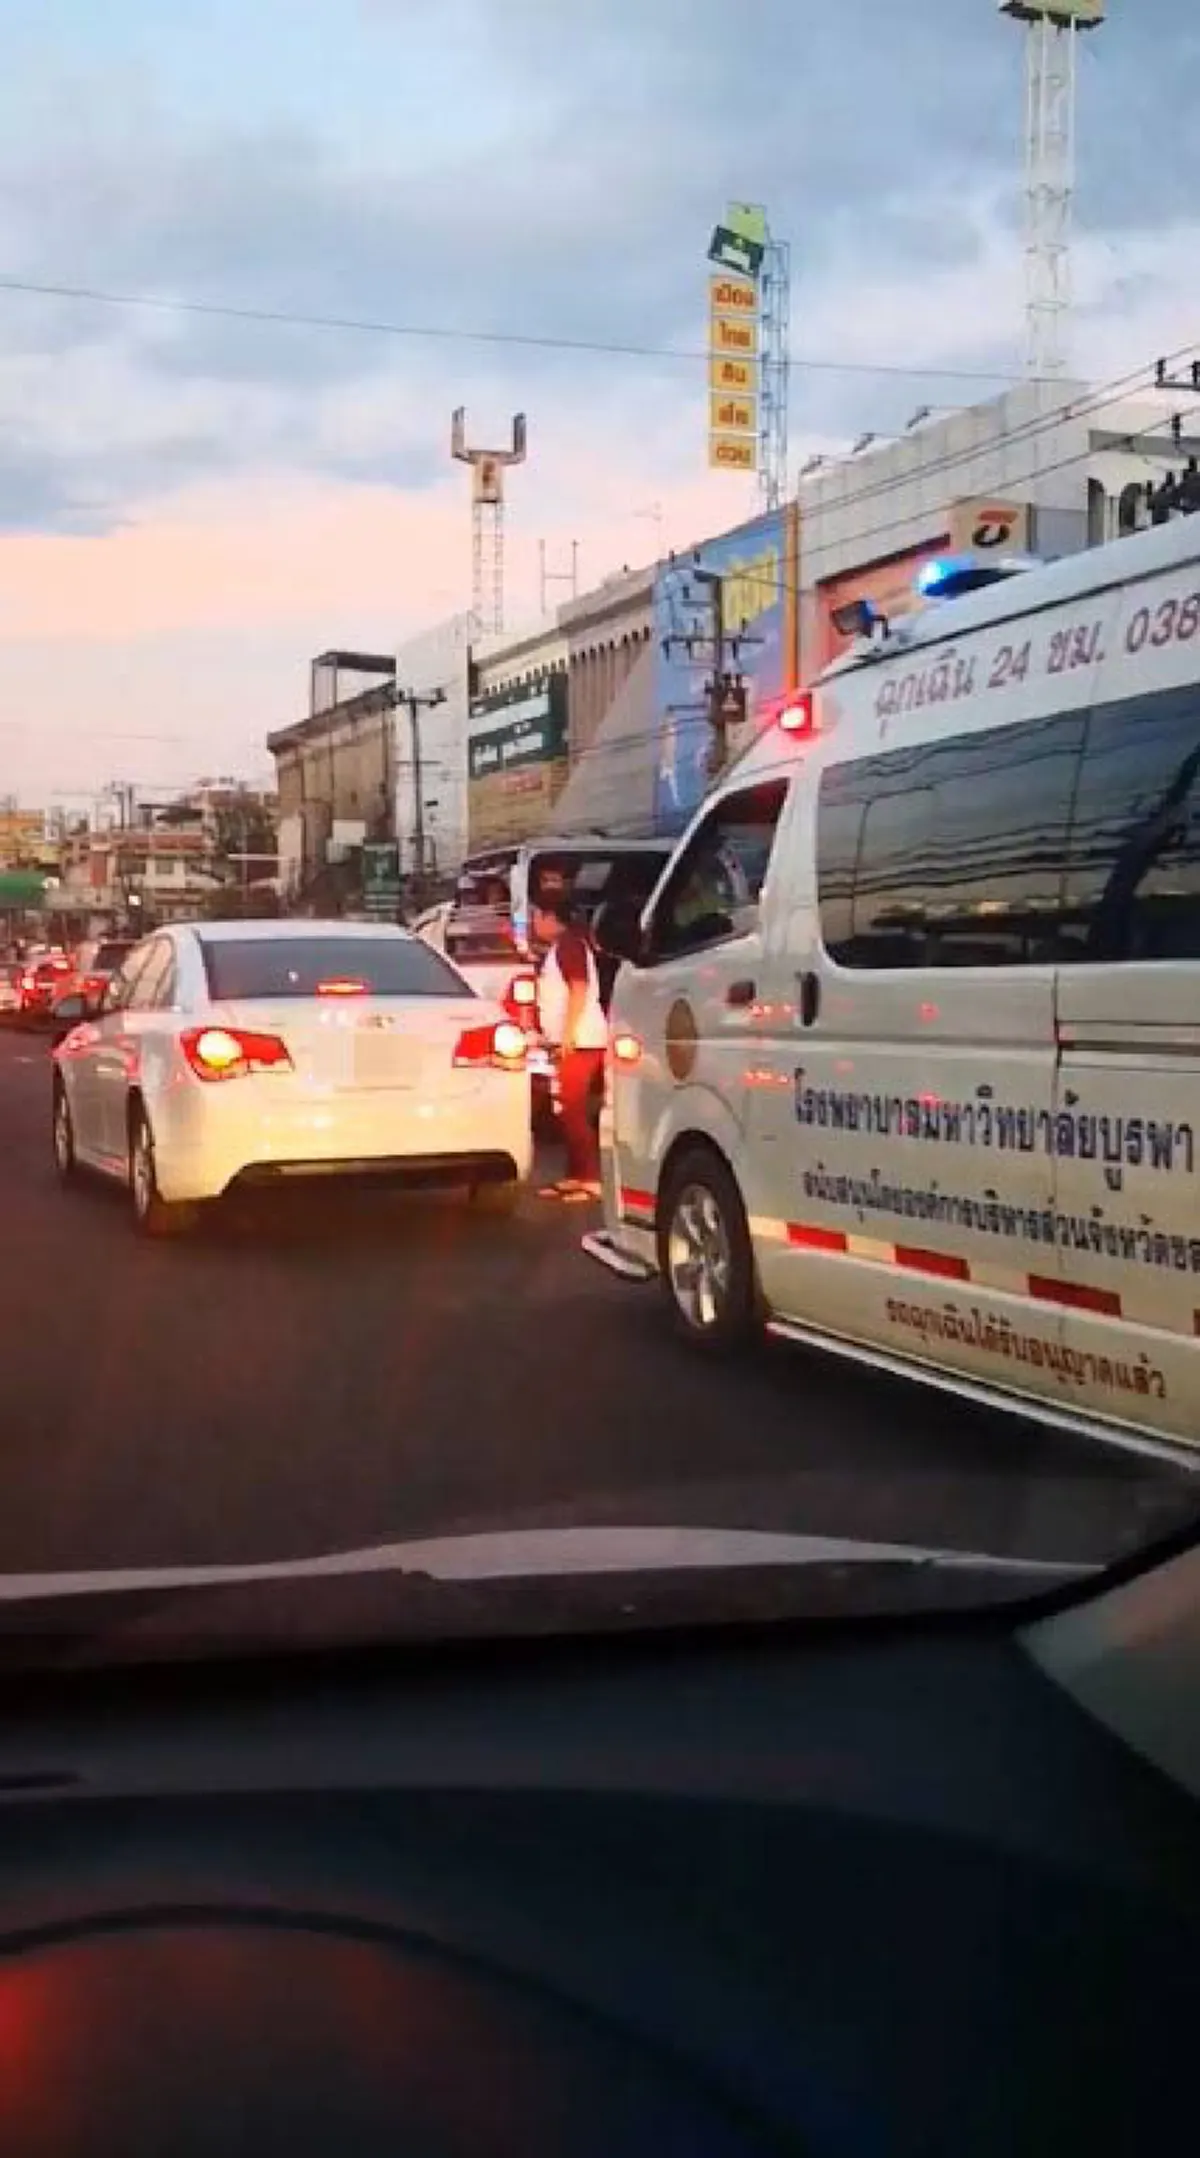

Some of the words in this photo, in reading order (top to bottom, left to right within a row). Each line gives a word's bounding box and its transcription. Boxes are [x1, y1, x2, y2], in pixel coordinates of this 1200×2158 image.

[875, 648, 977, 739] ฉุกเฉิน
[986, 640, 1032, 689] 24
[1126, 592, 1200, 654] 038
[794, 1066, 1194, 1192] โรงพยาบาลมหาวิทยาลัยบูรพา
[886, 1297, 1167, 1399] รถฉุกเฉินได้รับอนุญาตแล้ว
